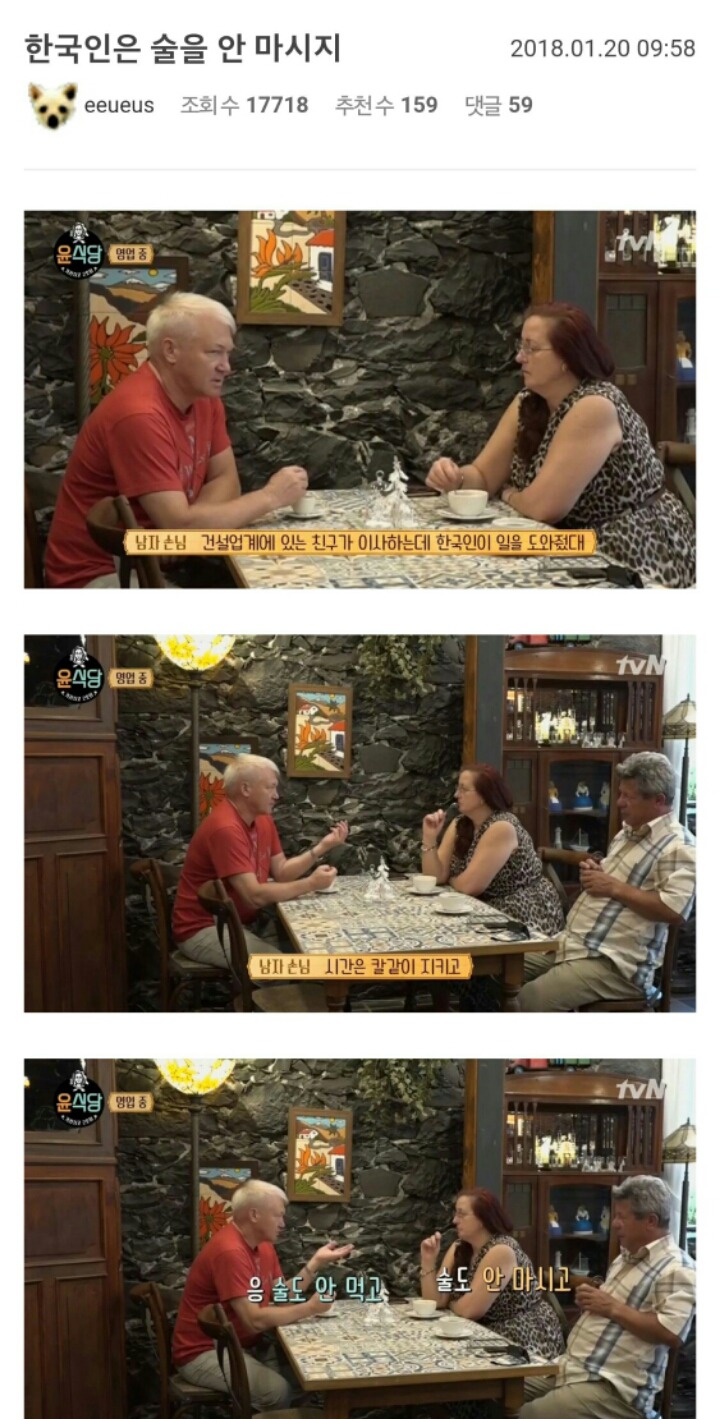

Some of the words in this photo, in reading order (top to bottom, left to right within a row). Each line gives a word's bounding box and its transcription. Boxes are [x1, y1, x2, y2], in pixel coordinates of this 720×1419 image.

[24, 33, 141, 64] 한국인은
[150, 33, 208, 64] 술을
[218, 33, 246, 63] 안
[254, 33, 340, 63] 마시지
[510, 39, 630, 58] 2018.01.20
[637, 39, 696, 58] 09:58
[84, 98, 155, 113] eeueus
[246, 96, 309, 113] 17718
[400, 96, 438, 113] 159
[465, 95, 502, 116] 댓글
[508, 96, 533, 113] 59
